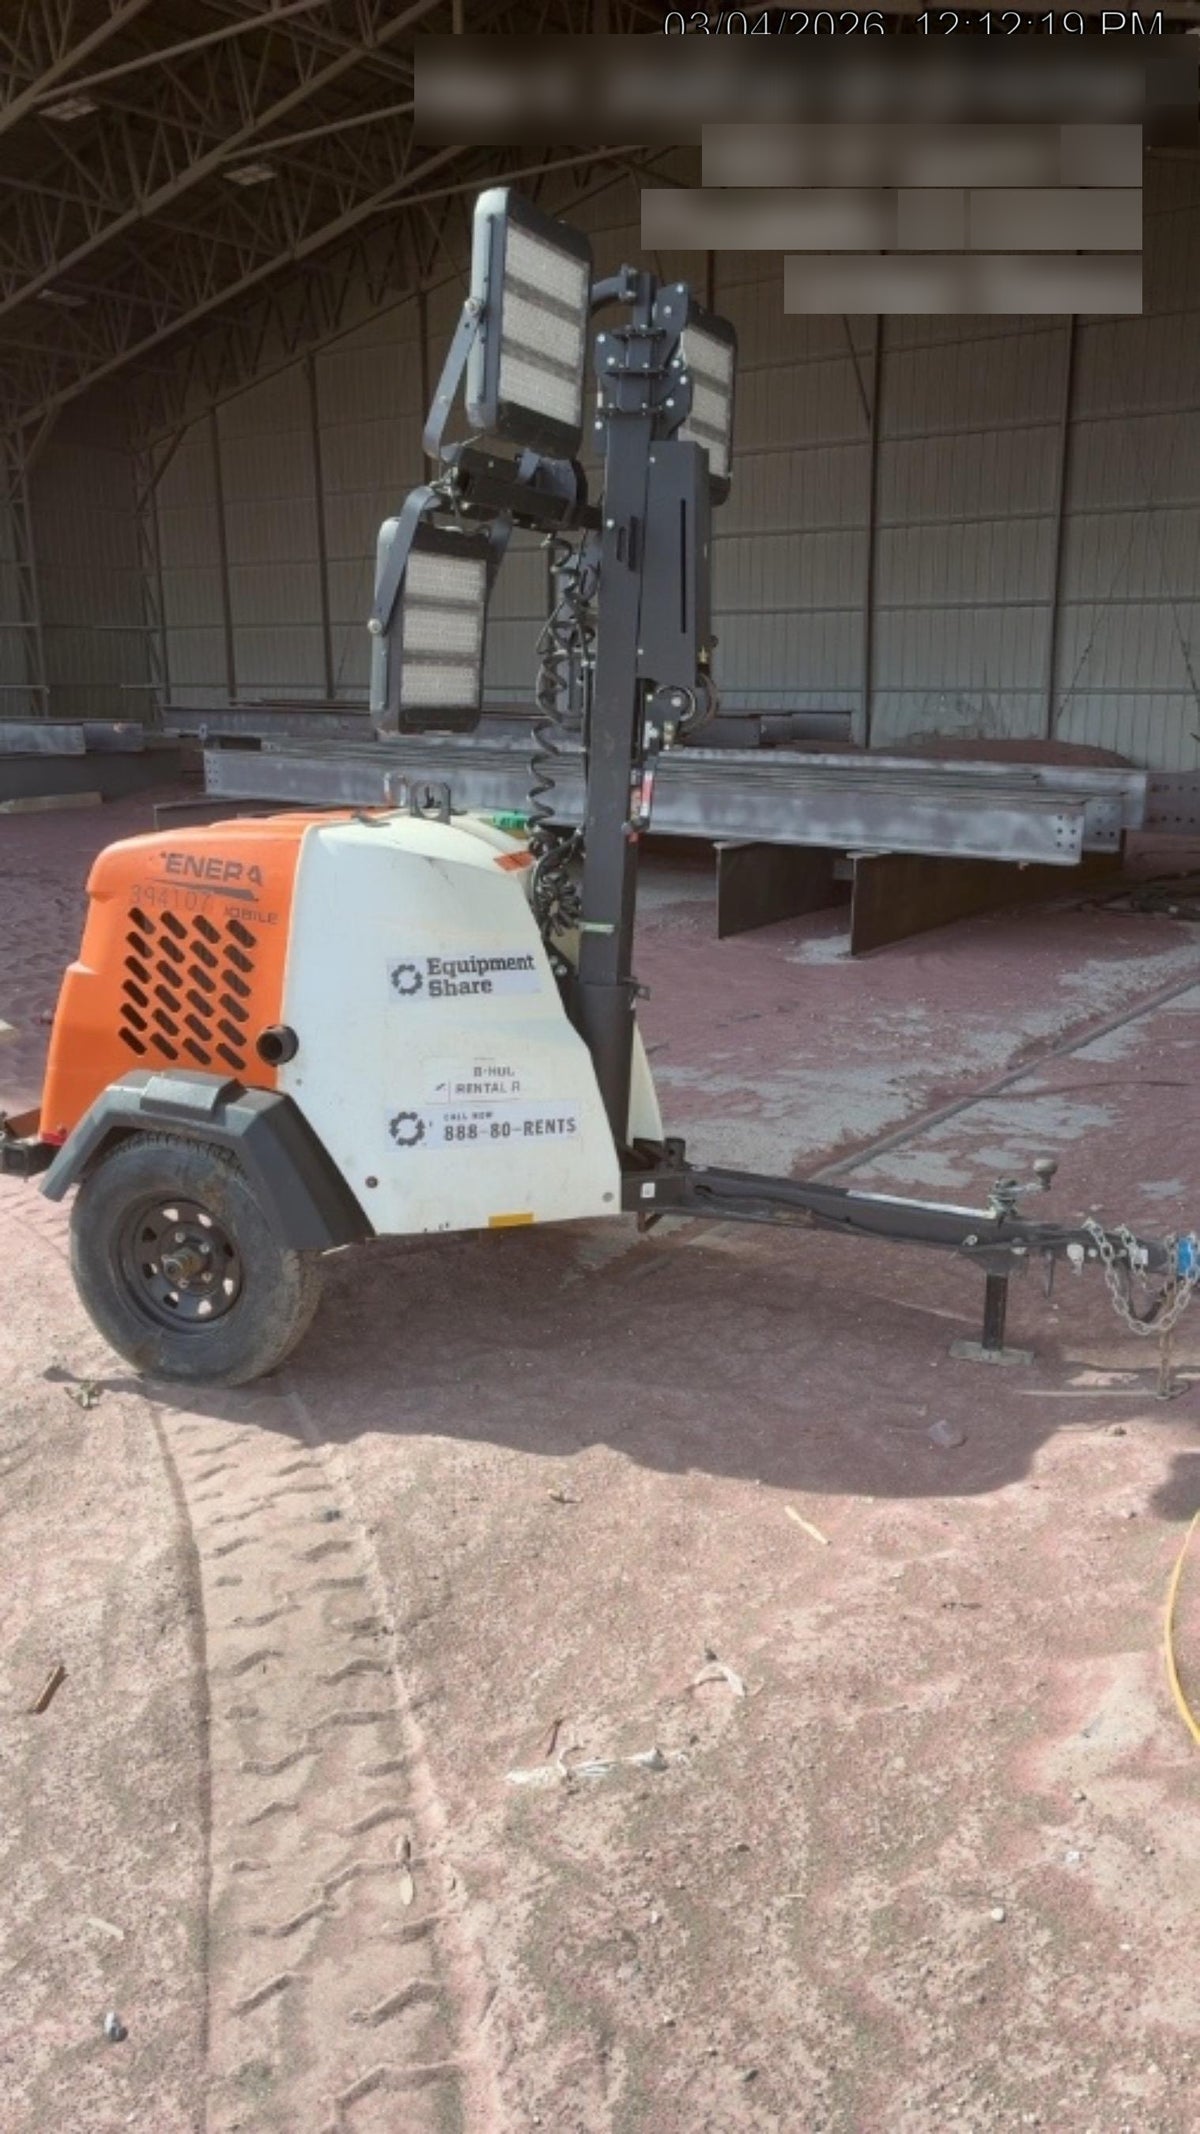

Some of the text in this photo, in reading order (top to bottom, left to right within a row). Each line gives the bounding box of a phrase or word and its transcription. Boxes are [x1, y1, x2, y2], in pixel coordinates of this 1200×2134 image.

[426, 954, 536, 977] Equipment
[428, 979, 493, 997] Share
[455, 1082, 508, 1095] RENTAL
[444, 1117, 577, 1142] 888-80-RENTS
